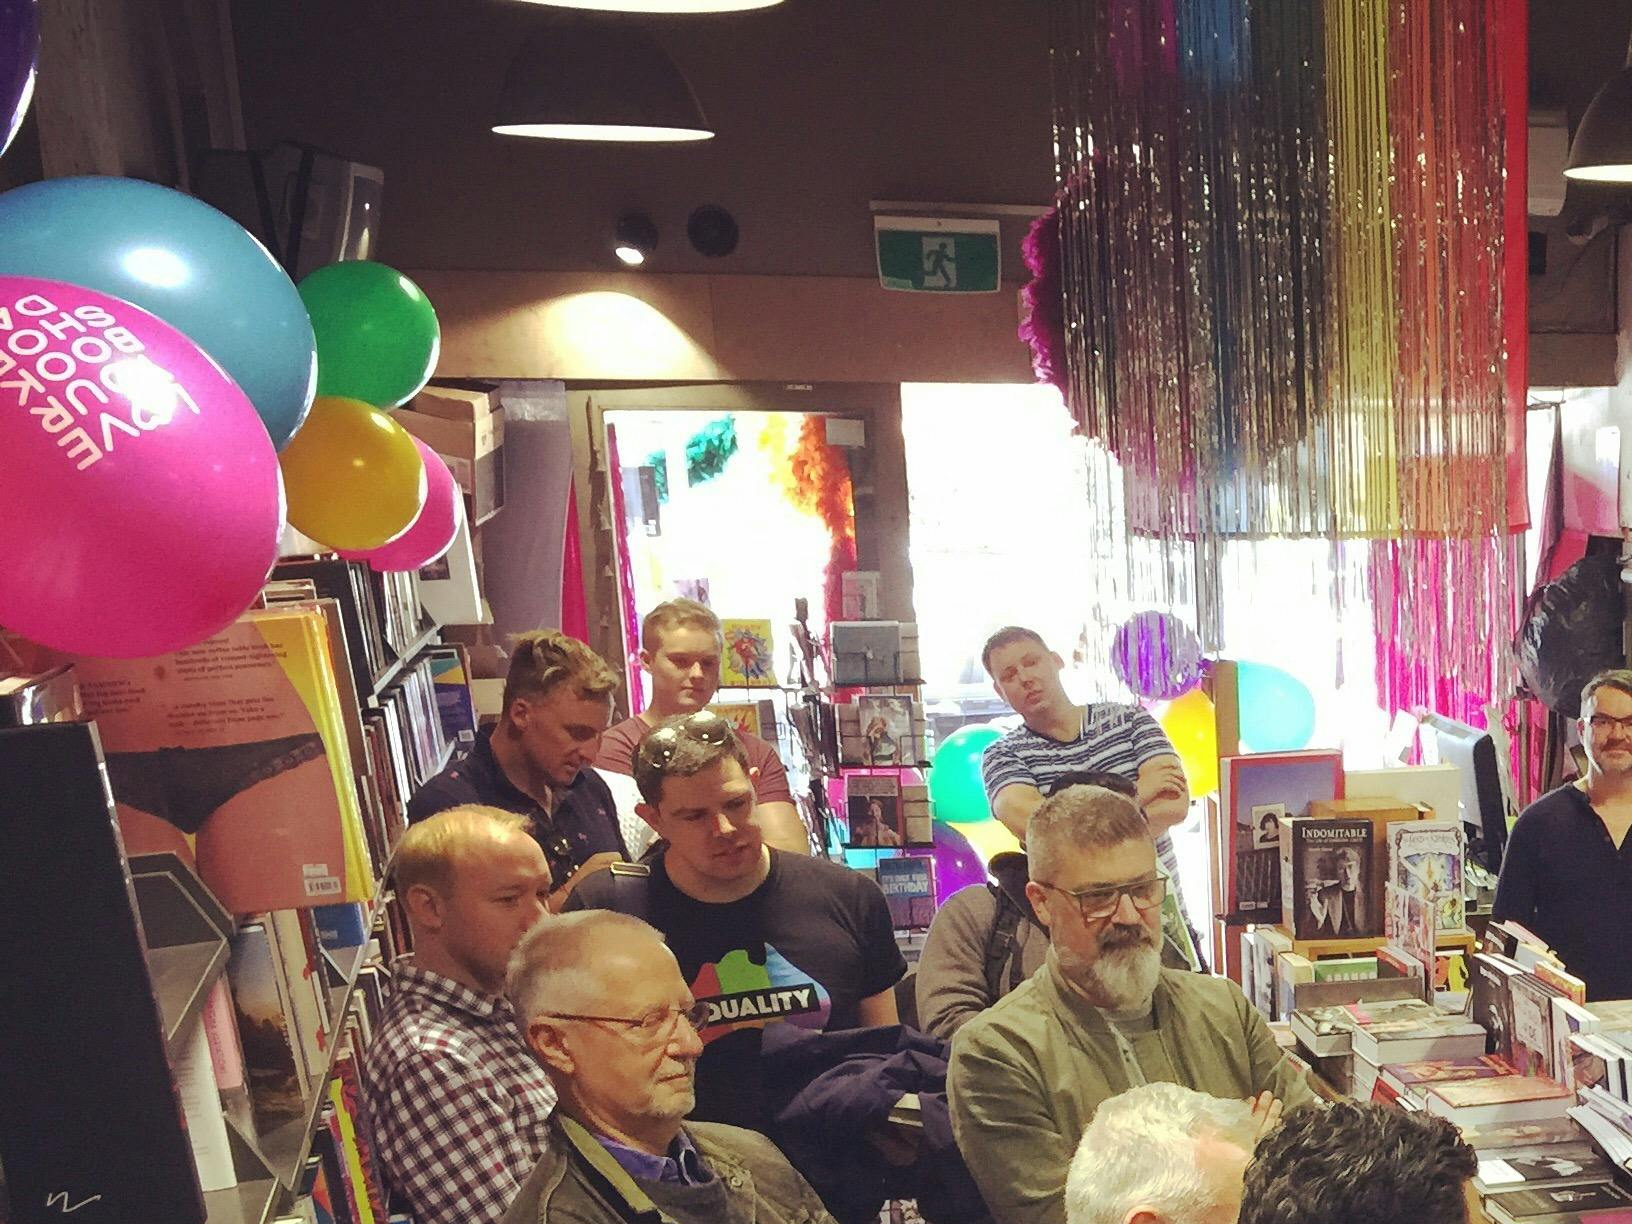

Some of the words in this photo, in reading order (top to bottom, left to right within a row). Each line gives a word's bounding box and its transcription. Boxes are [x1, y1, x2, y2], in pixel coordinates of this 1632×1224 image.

[0, 326, 145, 406] BOOK
[1302, 827, 1368, 838] INDOMITABLE
[882, 881, 929, 896] BIRTHDAY
[707, 988, 811, 1022] QUALITY
